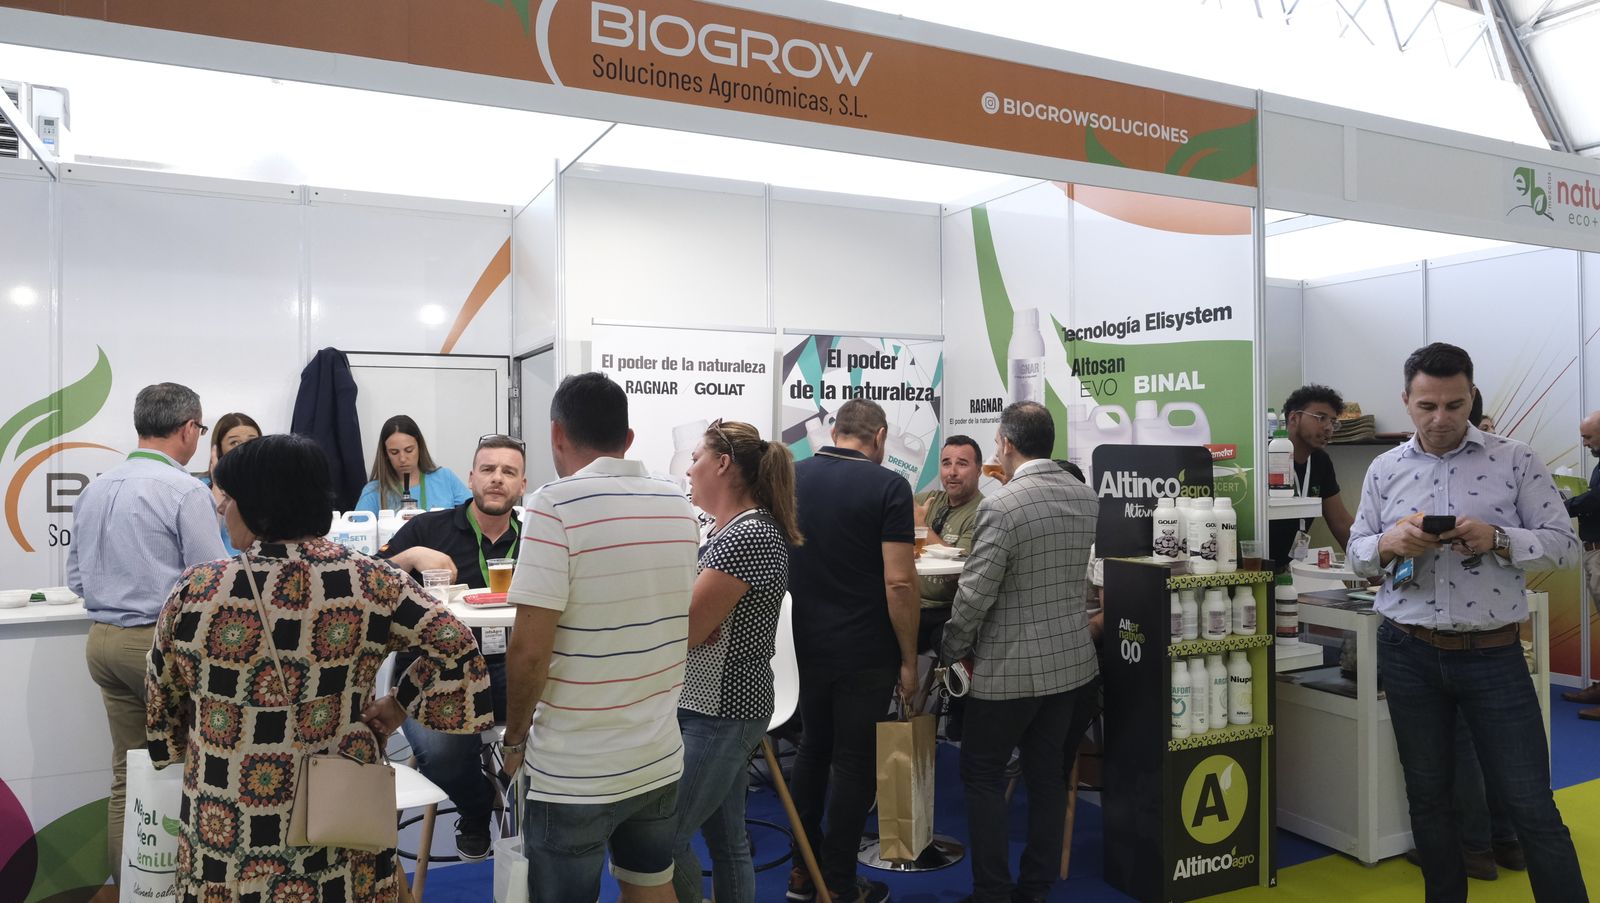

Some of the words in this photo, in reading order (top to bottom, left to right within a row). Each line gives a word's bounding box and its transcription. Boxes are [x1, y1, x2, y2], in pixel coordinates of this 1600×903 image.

[590, 1, 873, 87] BIOGROW
[592, 53, 703, 93] Soluciones
[708, 72, 832, 116] Agronómicas,
[838, 93, 868, 119] S.L.
[1003, 97, 1189, 145] BIOGROWSOLUCIONES
[1145, 305, 1232, 332] Elisystem
[601, 354, 614, 368] El
[618, 355, 658, 375] poder
[661, 356, 678, 371] de
[682, 356, 694, 372] la
[698, 358, 766, 374] naturaleza
[827, 349, 842, 368] El
[847, 349, 899, 373] poder
[1071, 357, 1126, 377] Altosan
[625, 380, 678, 396] RAGNAR
[694, 382, 745, 396] GOLIAT
[790, 380, 813, 399] de
[820, 380, 836, 399] la
[842, 383, 935, 402] naturaleza
[1080, 378, 1118, 398] EVO
[1134, 371, 1206, 394] BINAL
[969, 397, 1004, 414] RAGNAR
[955, 418, 967, 426] poder
[1120, 639, 1142, 664] 0,0
[1230, 676, 1252, 684] Niup
